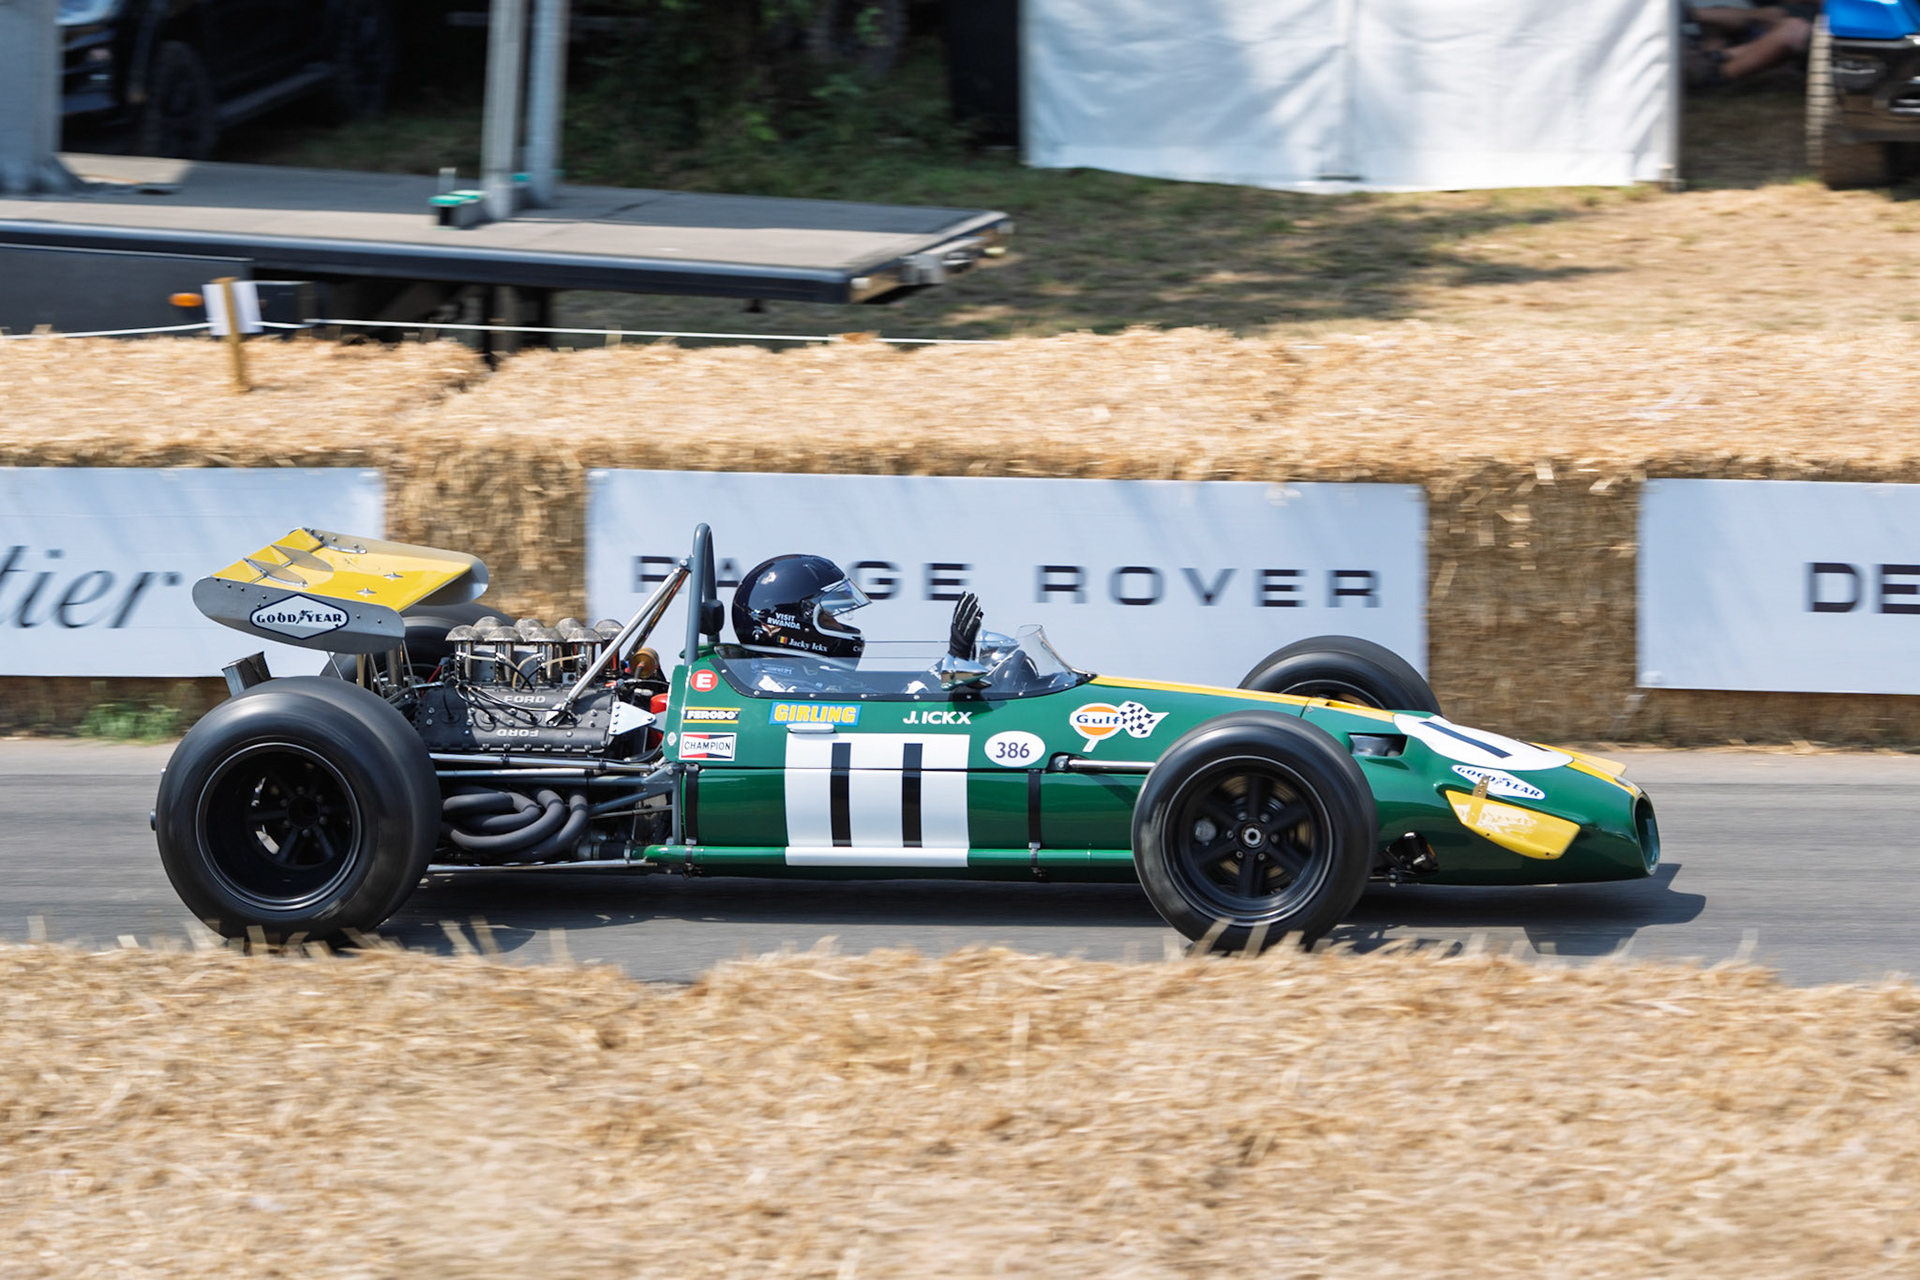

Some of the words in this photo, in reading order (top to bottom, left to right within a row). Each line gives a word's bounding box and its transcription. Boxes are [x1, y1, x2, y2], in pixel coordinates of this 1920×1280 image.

[631, 555, 975, 602] RAGE
[1034, 564, 1382, 608] ROVER
[767, 617, 801, 630] RWANDA
[775, 612, 796, 622] VISIT
[788, 638, 811, 651] Jacky
[811, 642, 828, 652] Ickx
[696, 673, 713, 688] E
[503, 695, 546, 704] FORD
[686, 710, 737, 720] FERODO
[774, 704, 857, 723] GIRLING
[1076, 714, 1120, 725] Gulf
[496, 729, 539, 737] FORD
[684, 741, 731, 751] CHAMPION
[995, 741, 1030, 759] 386
[829, 743, 923, 848] 11
